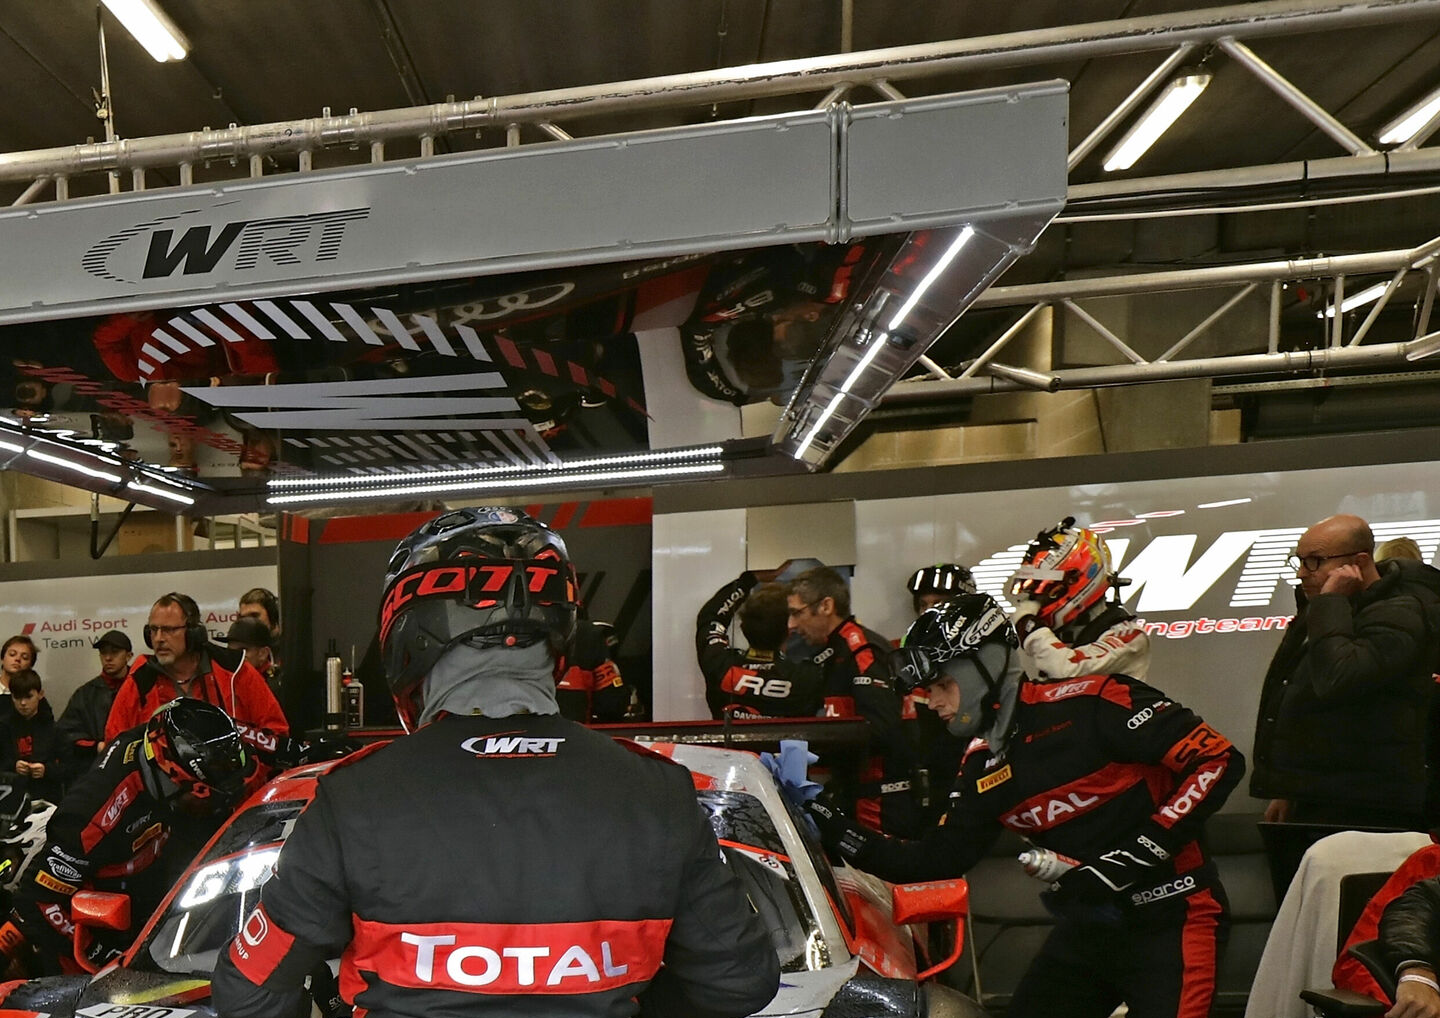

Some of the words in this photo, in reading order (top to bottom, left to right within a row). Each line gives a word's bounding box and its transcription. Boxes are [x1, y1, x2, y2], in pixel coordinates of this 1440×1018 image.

[40, 621, 78, 633] Audi
[81, 617, 129, 632] Sport
[42, 637, 84, 650] Team
[733, 673, 793, 699] R8
[485, 737, 566, 755] WRT
[980, 767, 1010, 792] PIRELLI
[1161, 765, 1223, 821] TOTAL
[1131, 874, 1196, 904] sparco
[401, 931, 629, 987] TOTAL
